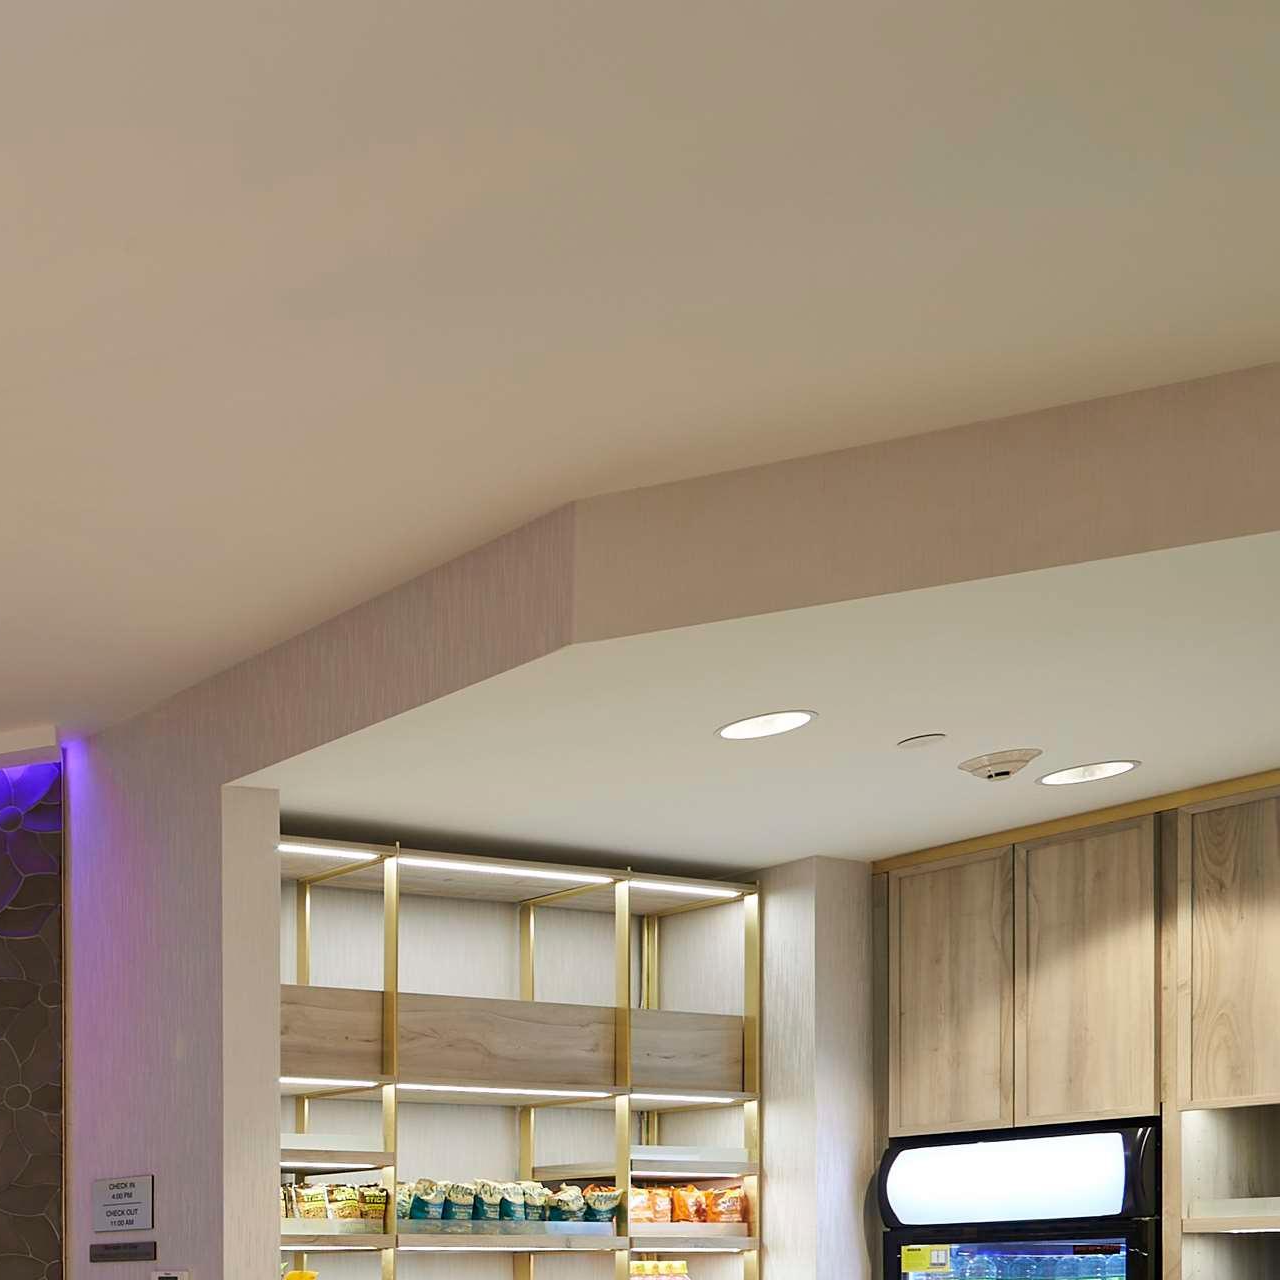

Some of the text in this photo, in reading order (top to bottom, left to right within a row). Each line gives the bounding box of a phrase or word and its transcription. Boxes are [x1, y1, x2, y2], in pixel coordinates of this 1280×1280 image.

[109, 1182, 127, 1190] CHECK
[124, 1191, 133, 1199] PM
[106, 1208, 138, 1217] CHECK OUT
